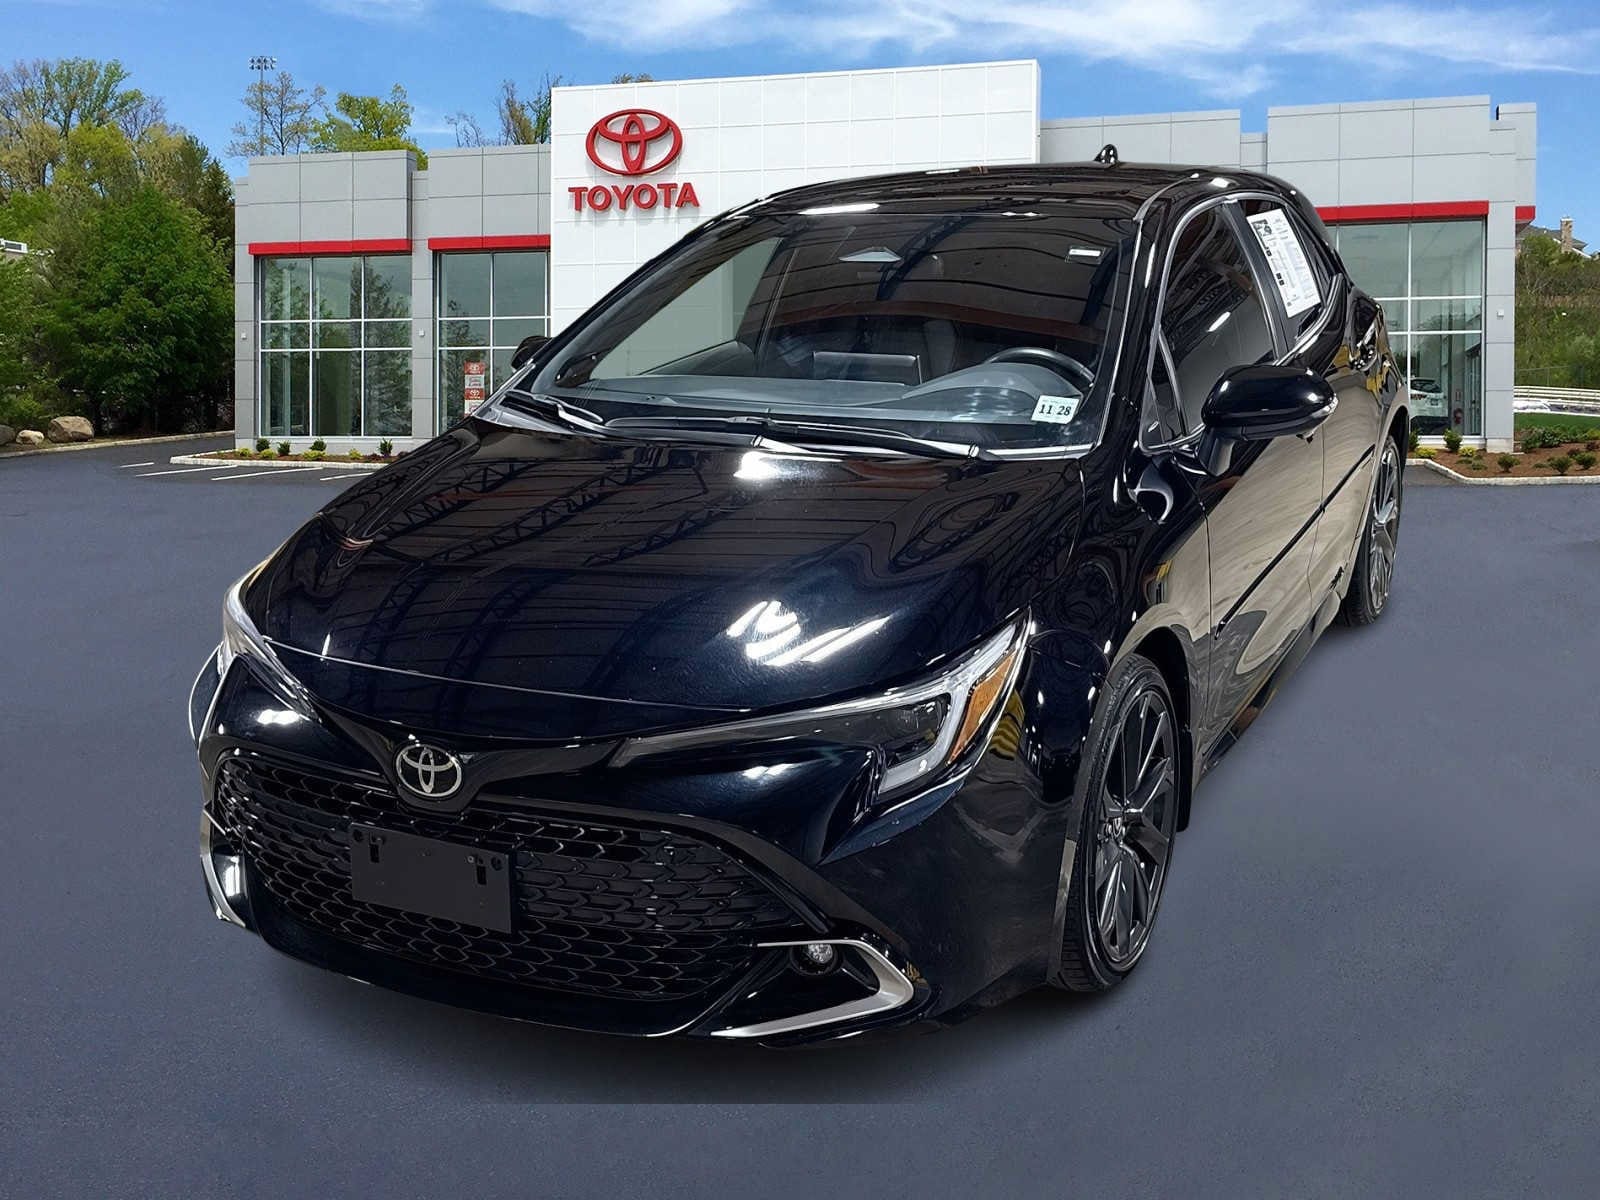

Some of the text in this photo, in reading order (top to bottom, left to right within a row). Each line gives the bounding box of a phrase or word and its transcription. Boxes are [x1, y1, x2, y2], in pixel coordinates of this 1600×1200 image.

[568, 182, 700, 212] TOYOTA
[1039, 404, 1072, 416] 11 28
